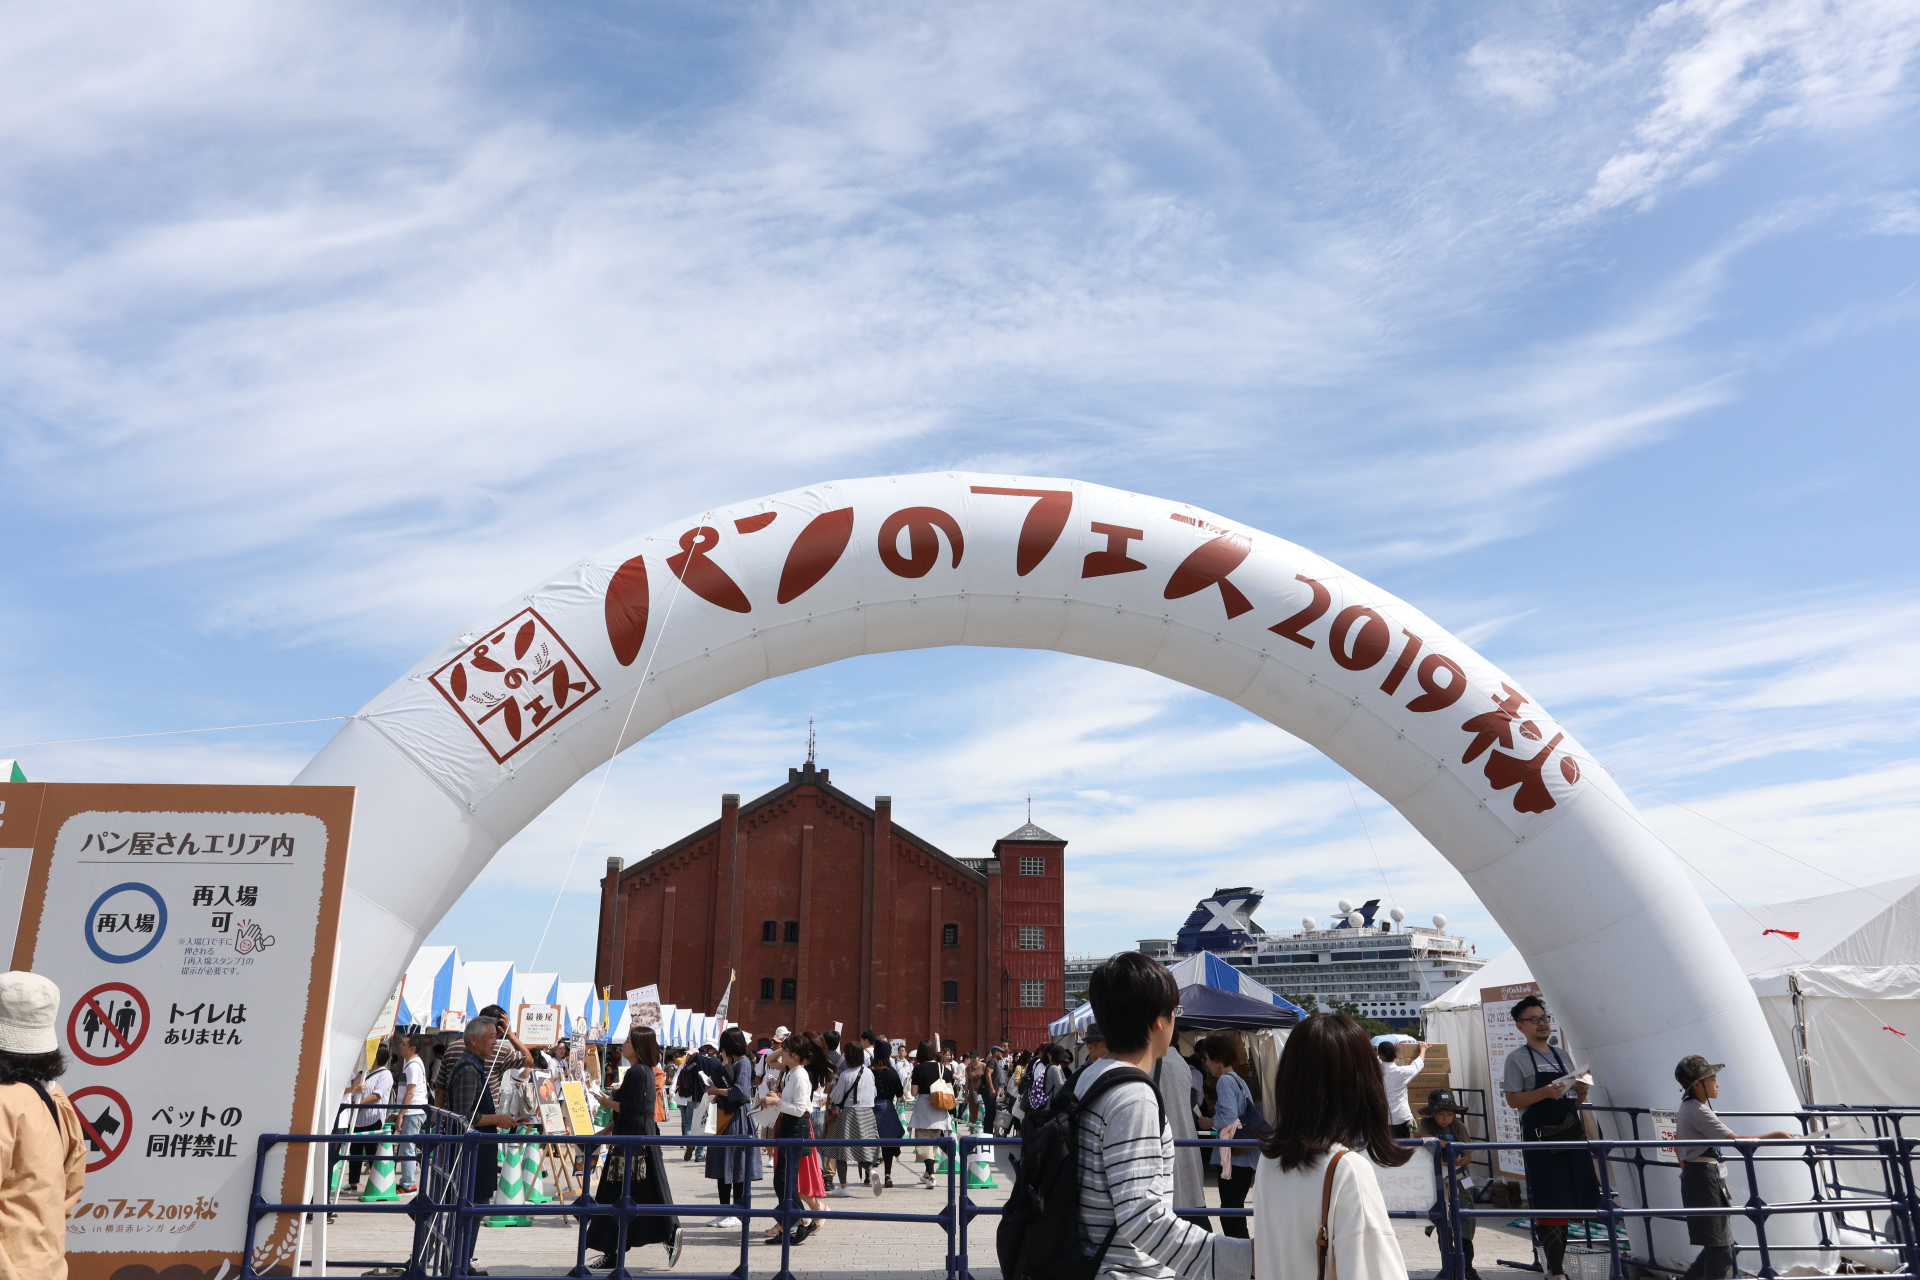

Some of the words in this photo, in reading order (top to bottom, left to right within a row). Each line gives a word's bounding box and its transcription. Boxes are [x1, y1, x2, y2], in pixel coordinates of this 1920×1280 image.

[449, 619, 536, 702] パン
[503, 668, 528, 690] の
[477, 660, 587, 743] フェス
[80, 831, 295, 858] パン屋さんエリア内
[192, 884, 259, 908] 再入場
[97, 913, 156, 934] 再入場
[211, 911, 232, 934] 可
[1200, 898, 1247, 932] X
[184, 947, 215, 956] 押される
[168, 1003, 247, 1024] トイレは
[525, 1012, 554, 1022] 最後尾
[164, 1028, 243, 1046] ありません
[151, 1105, 242, 1128] ペットの
[145, 1133, 237, 1159] 同伴禁止
[65, 1196, 220, 1220] ンのフェス2019秋
[92, 1224, 102, 1233] in
[105, 1224, 165, 1233] 横浜赤レンガ
